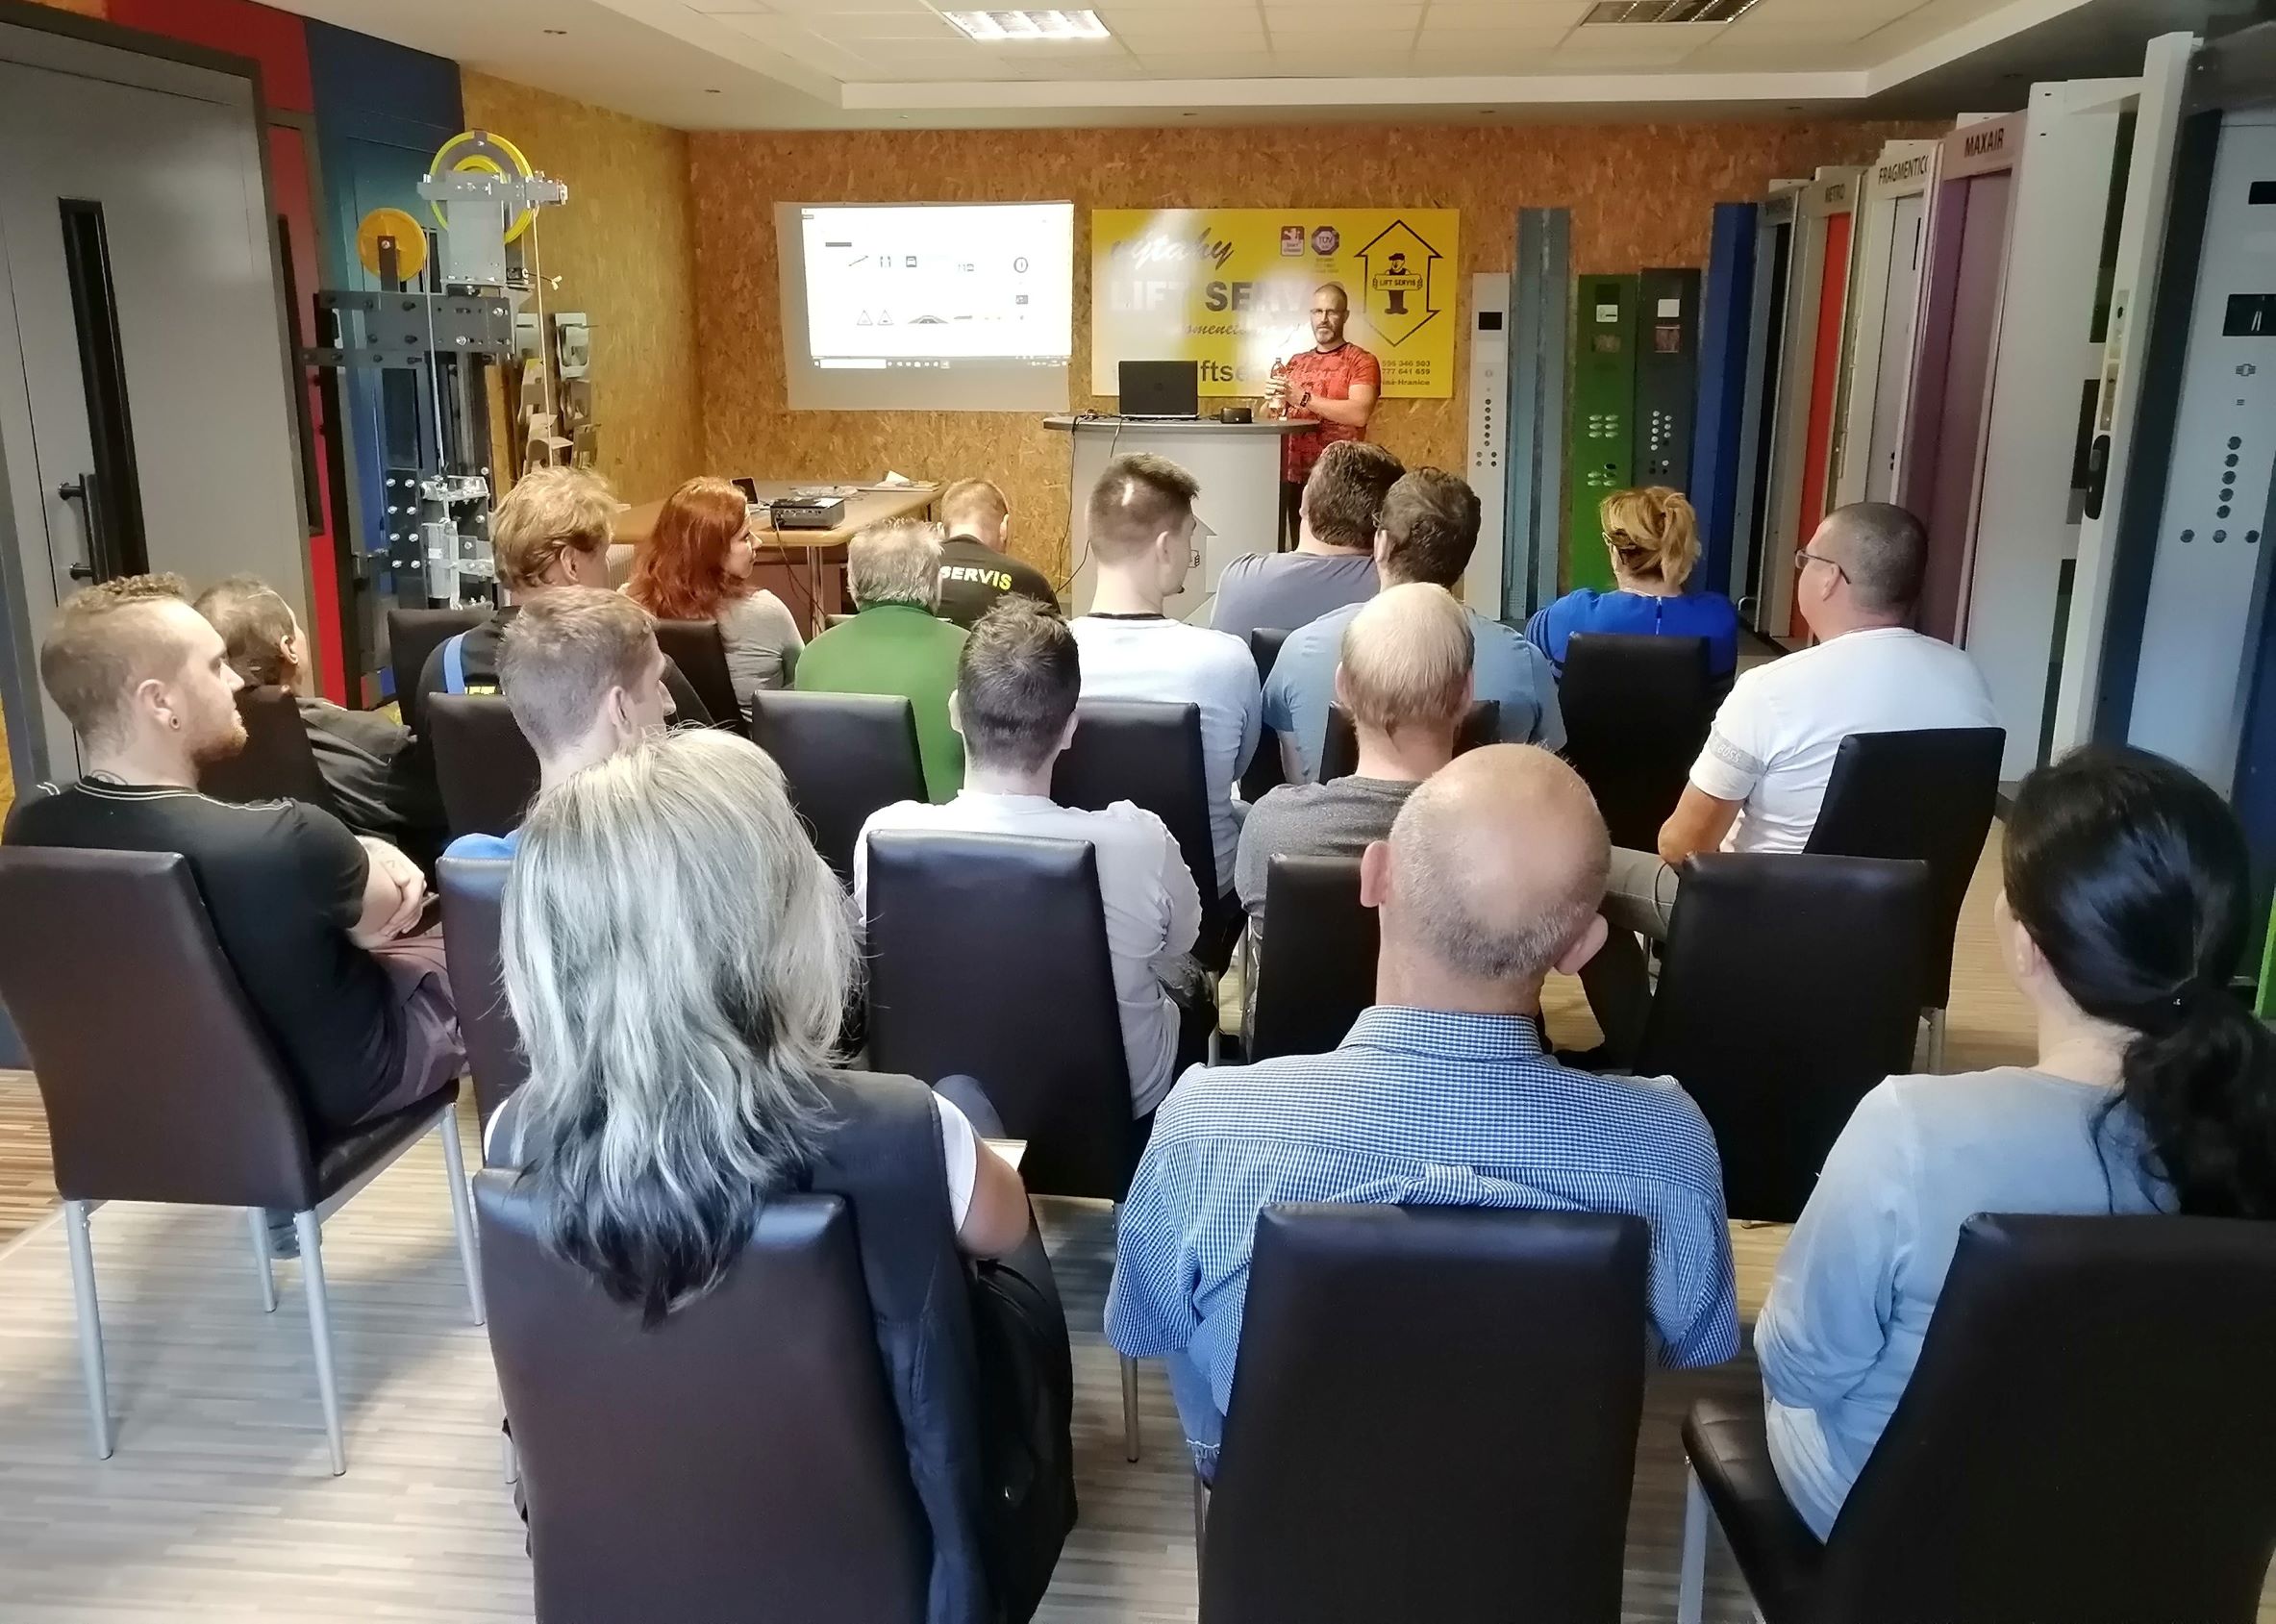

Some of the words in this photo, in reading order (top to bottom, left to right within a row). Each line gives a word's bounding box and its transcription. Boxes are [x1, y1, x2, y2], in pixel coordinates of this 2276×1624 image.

[1964, 128, 2005, 158] MAXAIR
[938, 565, 1013, 590] SERVIS
[1717, 744, 1740, 763] BOSS
